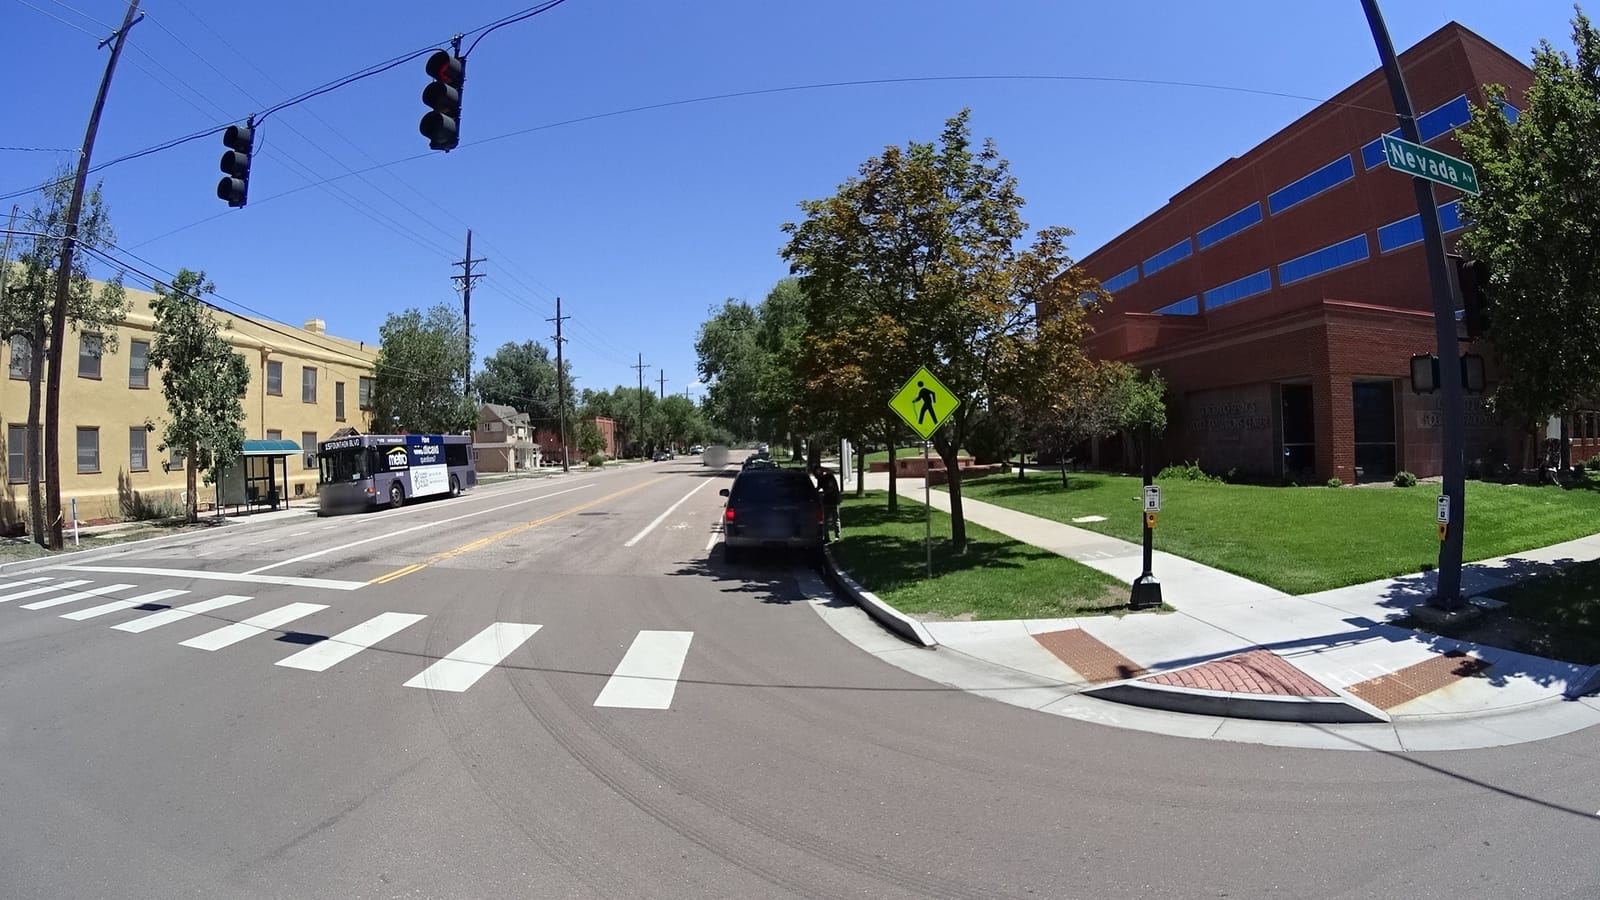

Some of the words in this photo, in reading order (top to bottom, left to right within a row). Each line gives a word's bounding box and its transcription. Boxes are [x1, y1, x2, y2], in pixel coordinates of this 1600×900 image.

[1390, 142, 1458, 183] Nevada
[1462, 171, 1473, 183] Av
[389, 451, 408, 466] metro
